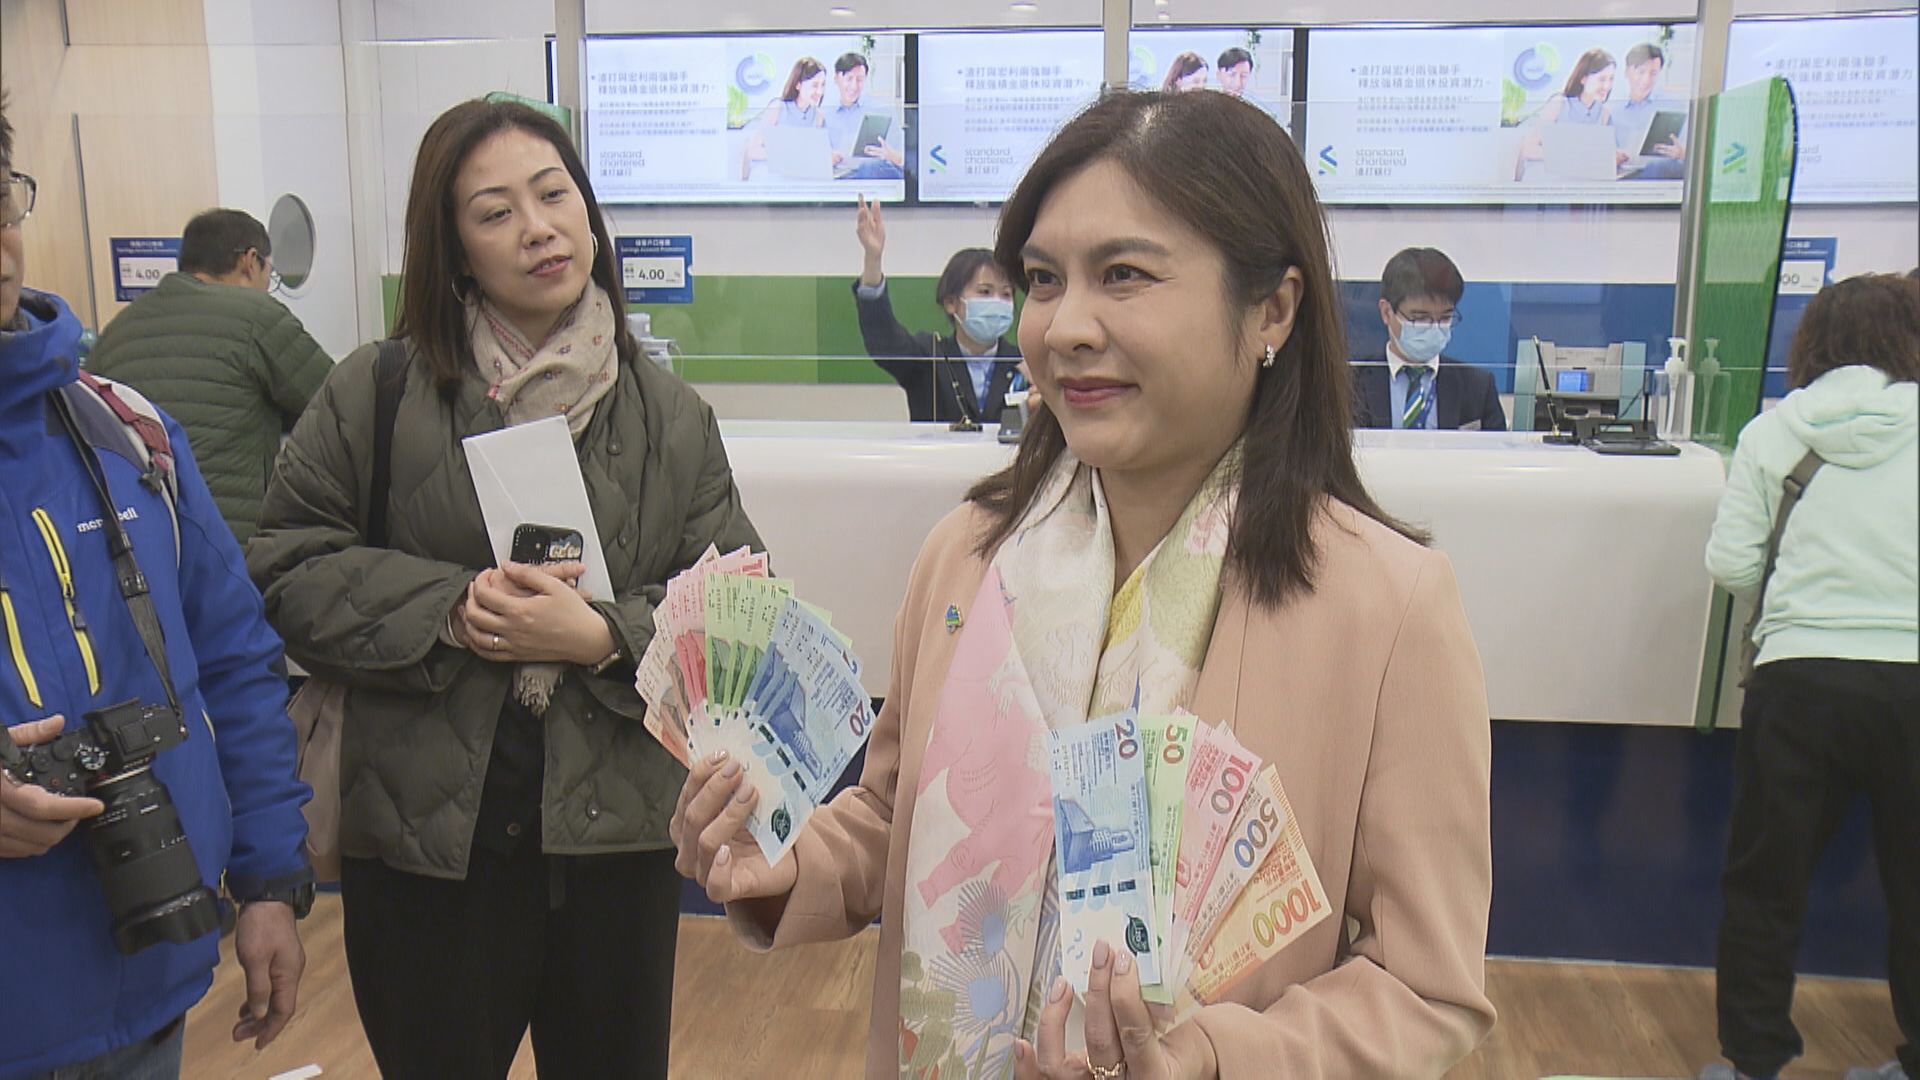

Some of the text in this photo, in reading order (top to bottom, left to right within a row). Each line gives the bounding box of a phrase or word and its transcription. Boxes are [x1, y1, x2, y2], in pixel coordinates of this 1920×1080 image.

[600, 149, 642, 159] standard
[964, 148, 1011, 157] standard
[1355, 147, 1404, 157] standard
[600, 158, 645, 168] chartered
[964, 156, 1014, 165] chartered
[1355, 156, 1407, 166] chartered
[135, 268, 160, 280] 4.00
[638, 268, 665, 280] 4.00
[850, 701, 871, 738] 20
[1115, 719, 1139, 760] 20
[1162, 723, 1188, 764] 50
[1210, 755, 1253, 815] 100
[1234, 798, 1279, 868] 500
[1252, 878, 1322, 948] 1000
